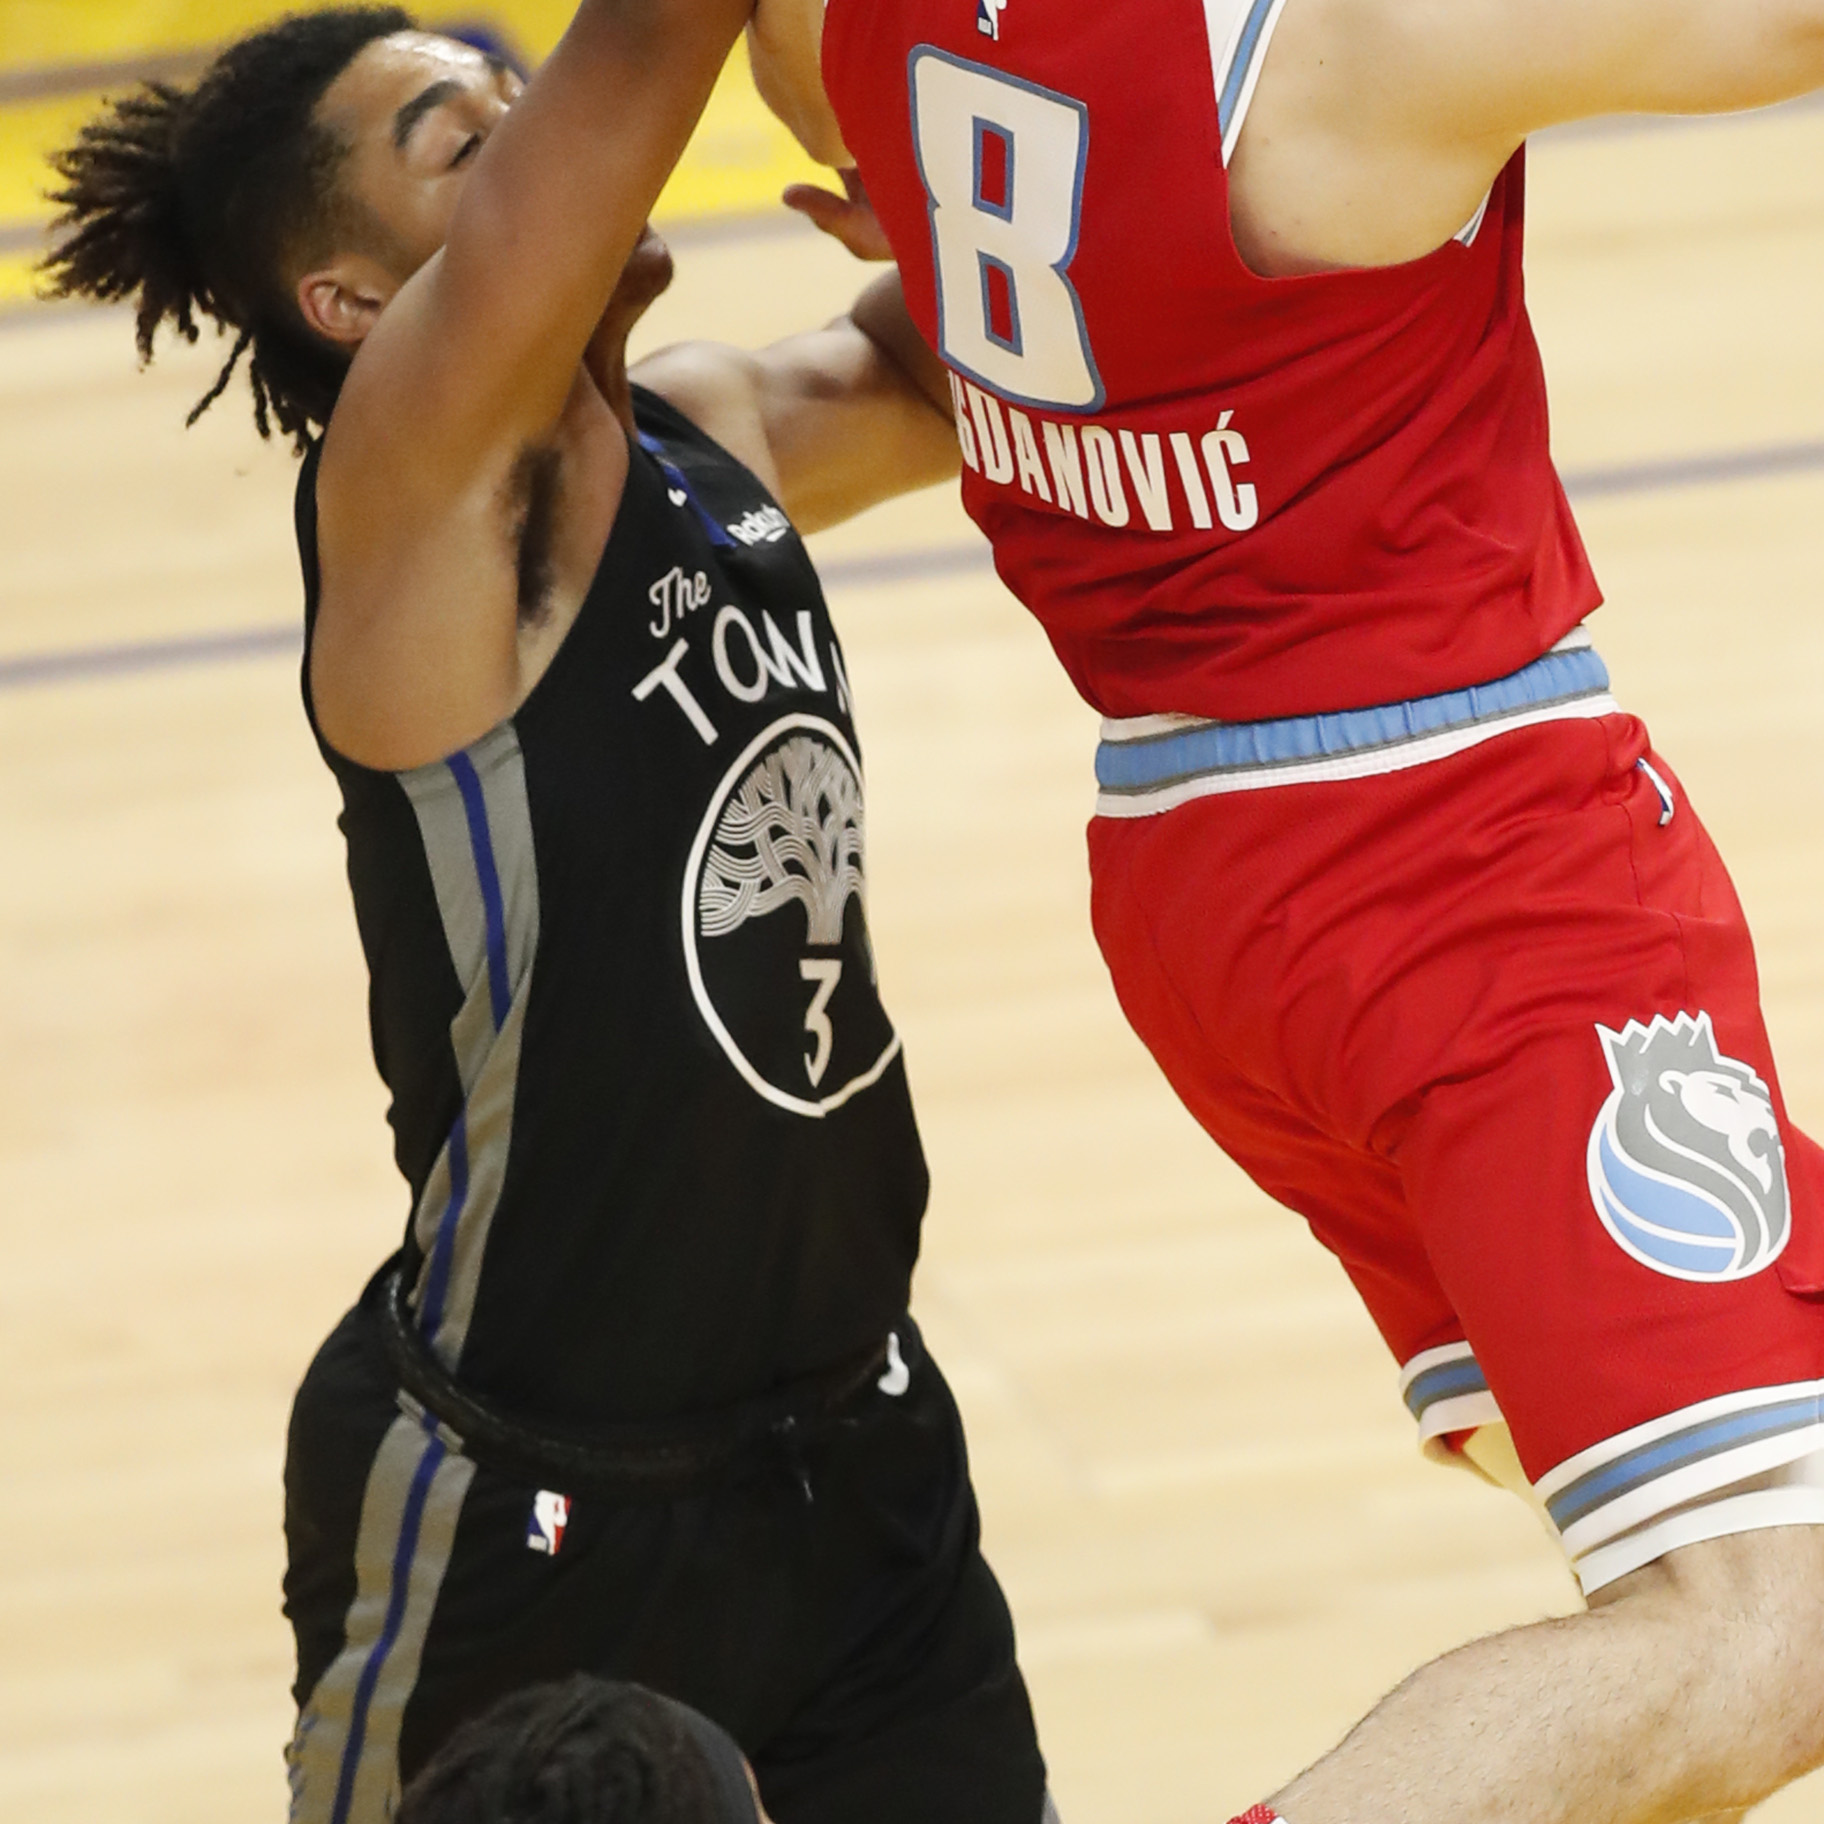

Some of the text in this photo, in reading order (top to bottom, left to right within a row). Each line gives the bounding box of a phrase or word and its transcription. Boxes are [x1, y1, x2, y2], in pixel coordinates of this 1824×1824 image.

[907, 43, 1107, 414] 8
[948, 369, 1259, 532] GDANOVIĆ
[648, 566, 712, 639] The
[799, 959, 842, 1088] 3
